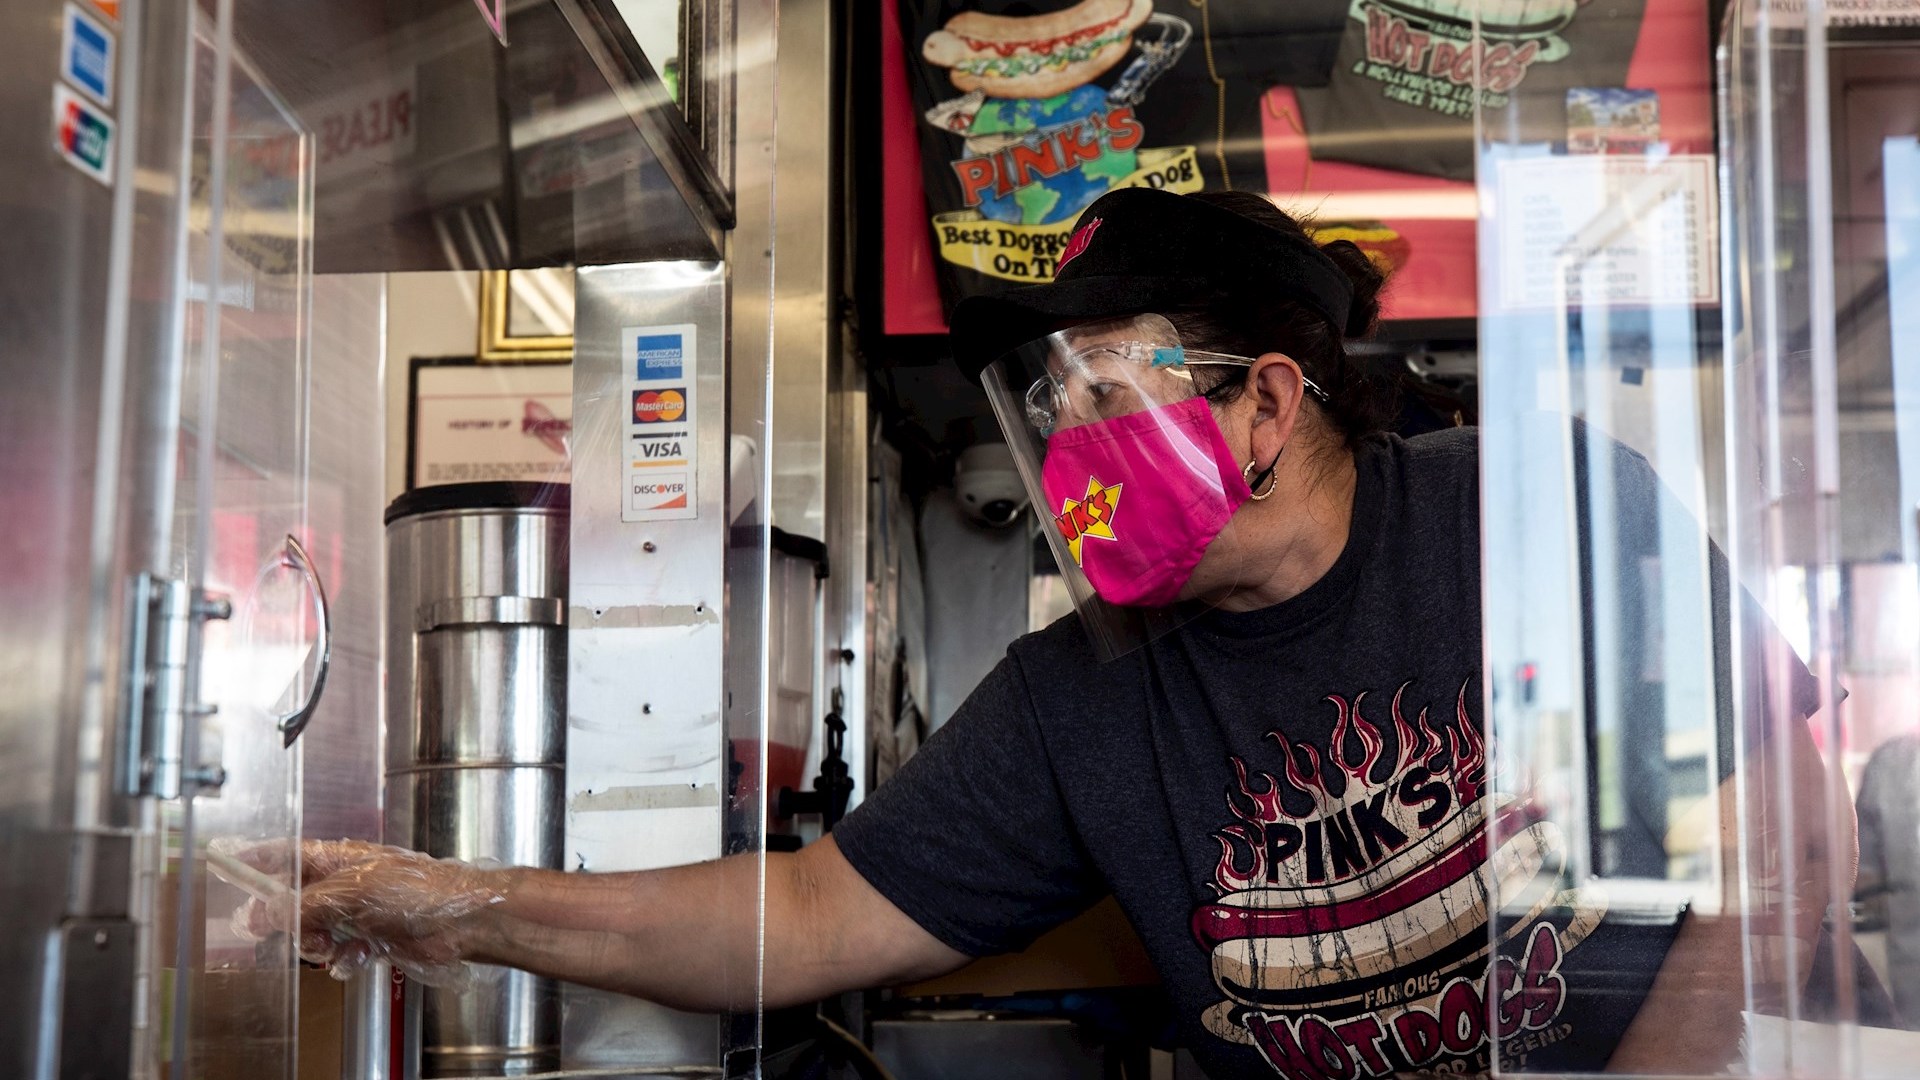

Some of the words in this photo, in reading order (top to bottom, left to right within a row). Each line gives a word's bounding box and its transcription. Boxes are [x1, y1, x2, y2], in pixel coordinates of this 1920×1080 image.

[1365, 5, 1430, 71] HOT
[1428, 38, 1540, 92] DOGS
[951, 106, 1145, 208] PINK'S
[943, 226, 993, 246] Best
[993, 253, 1029, 277] On
[638, 350, 681, 361] AMERICAN
[646, 359, 684, 369] EXPRESS
[635, 401, 684, 413] MasterCard
[641, 441, 682, 458] VISA
[634, 483, 684, 495] DISCOVER
[1265, 766, 1452, 884] PINK'S
[1242, 1010, 1389, 1080] HOT
[1394, 921, 1568, 1067] DOGS
[1363, 970, 1440, 1010] FAMOUS
